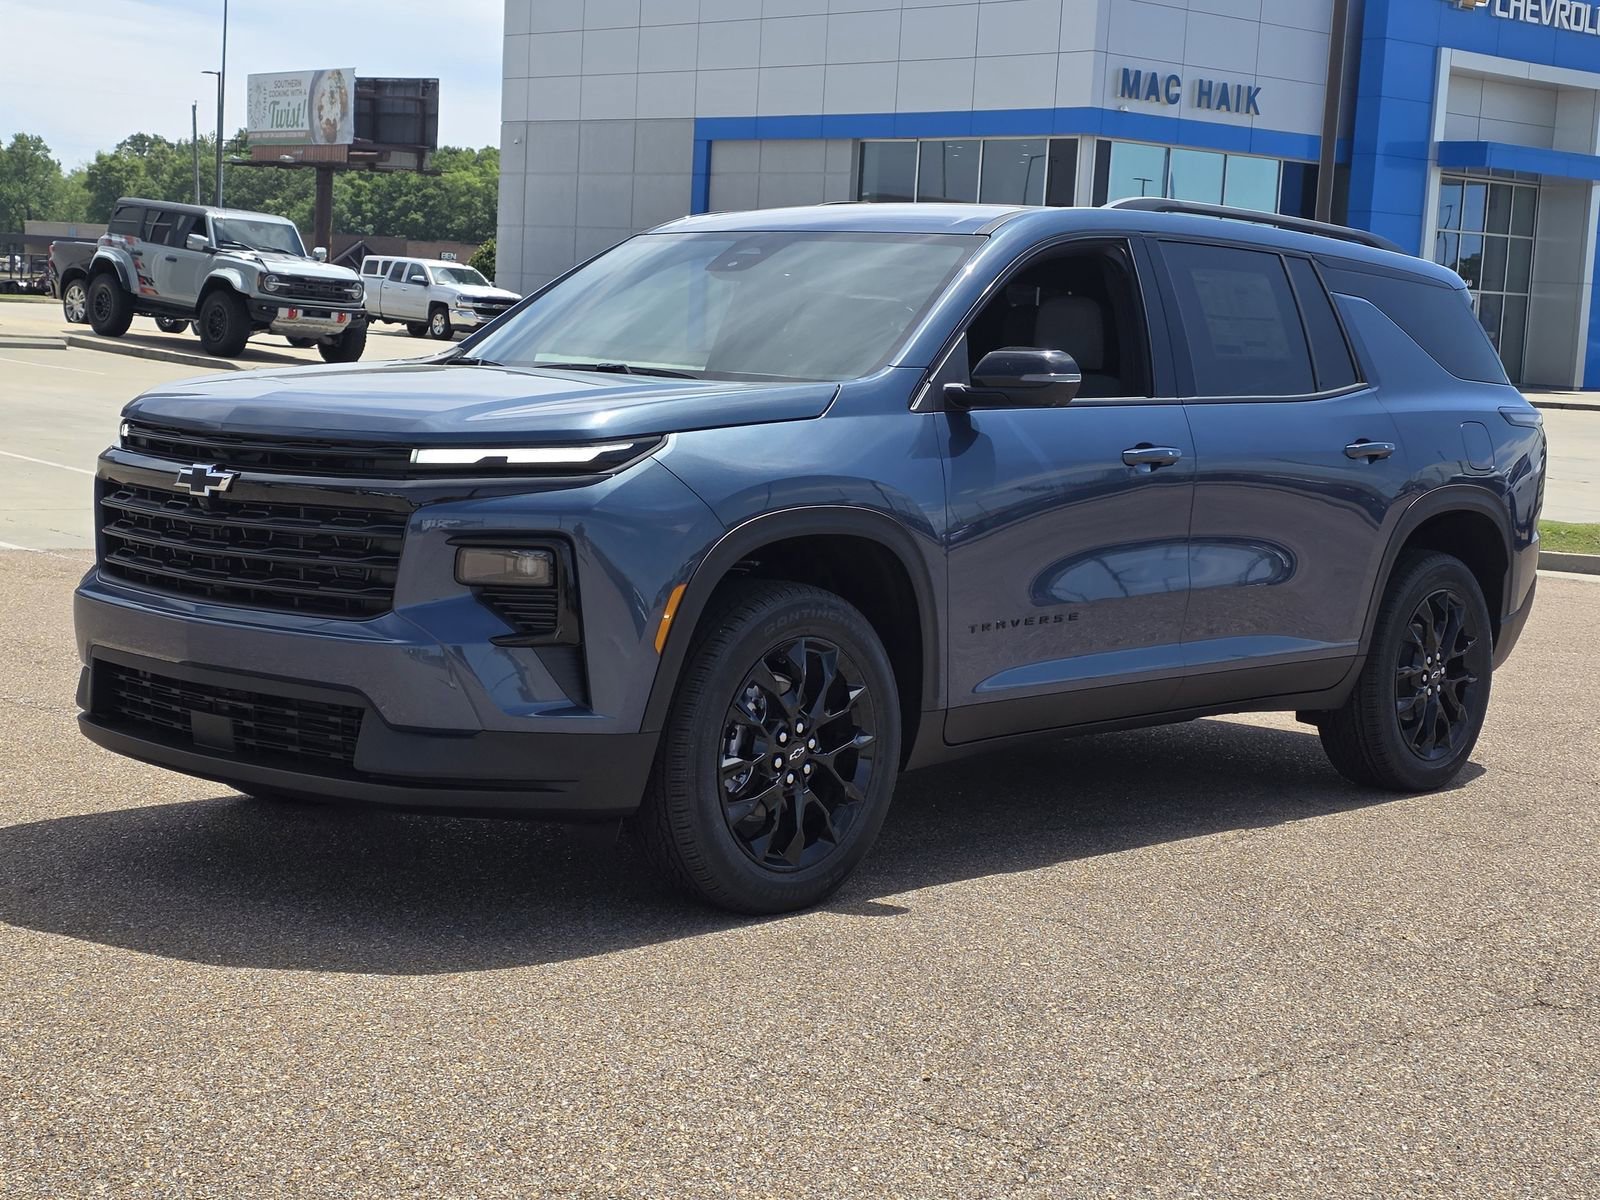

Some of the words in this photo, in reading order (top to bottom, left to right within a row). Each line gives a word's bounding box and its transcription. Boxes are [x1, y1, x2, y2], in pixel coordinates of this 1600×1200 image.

[273, 79, 302, 88] SOUTHERN
[1120, 67, 1182, 105] MAC
[1196, 78, 1262, 116] HAIK
[268, 99, 307, 129] Twist!
[441, 252, 457, 260] BEN
[968, 612, 1080, 634] TRAVERSE
